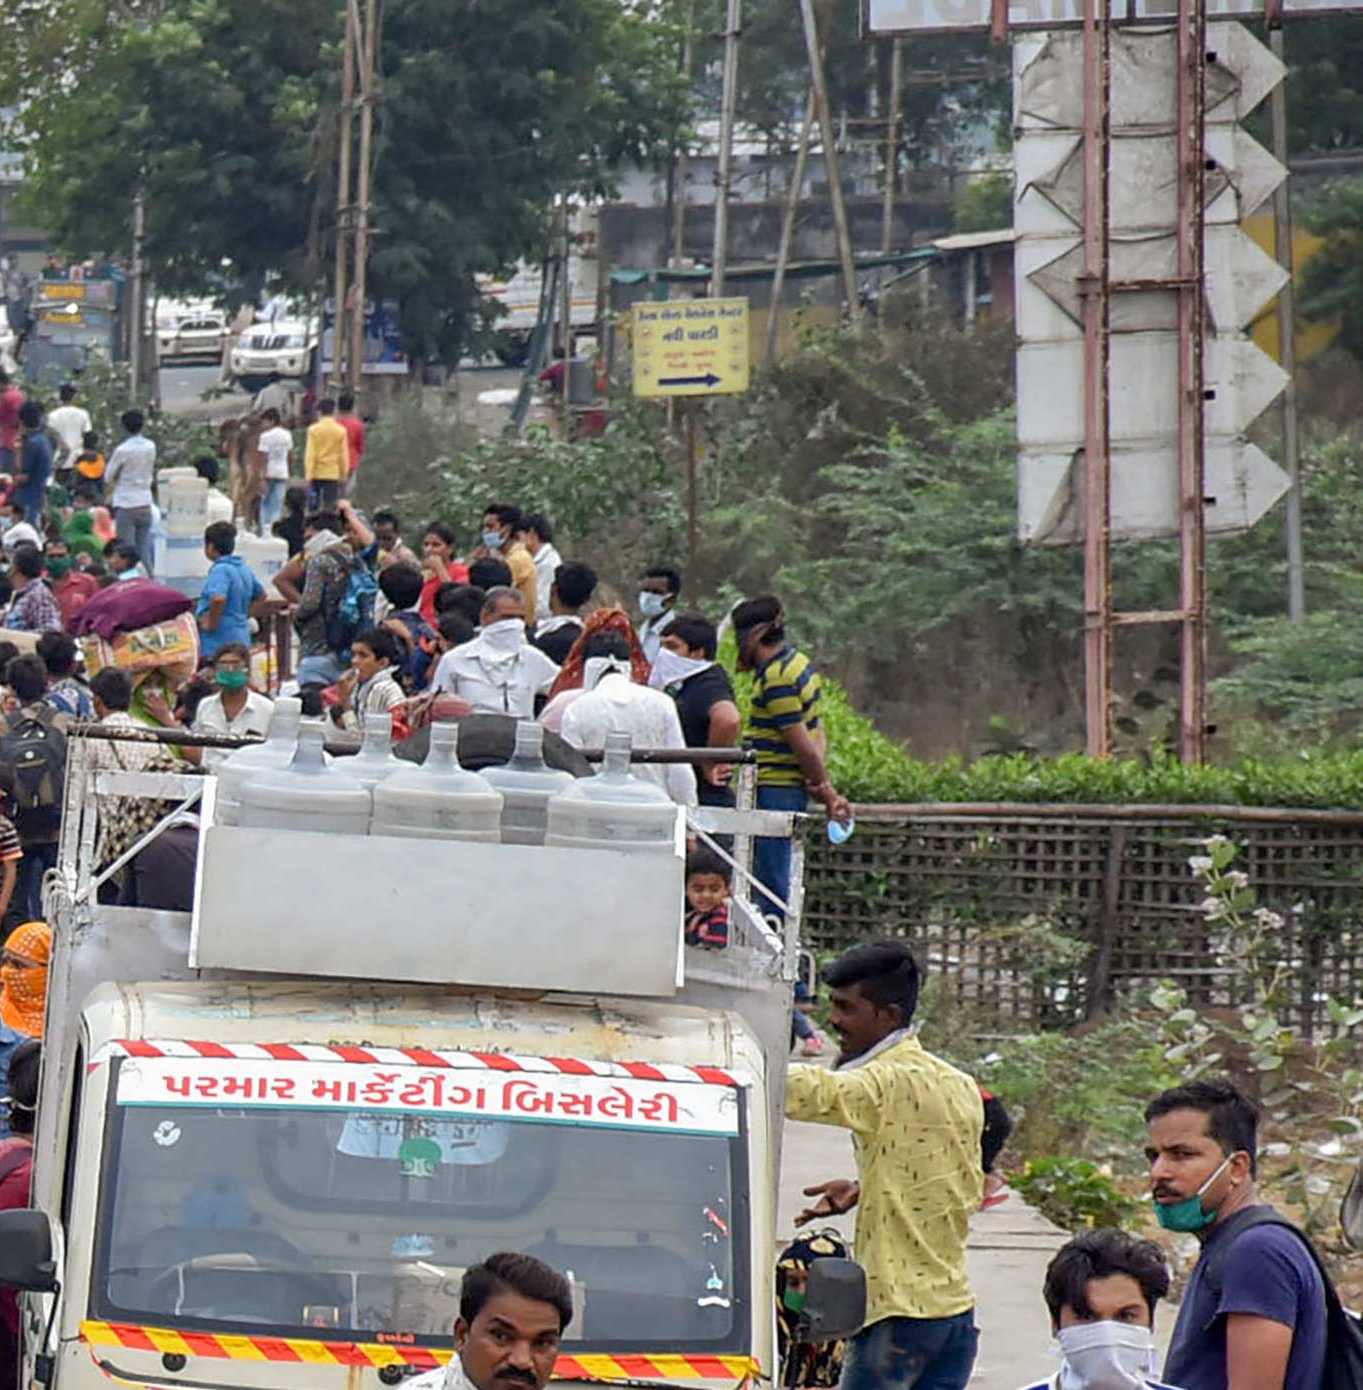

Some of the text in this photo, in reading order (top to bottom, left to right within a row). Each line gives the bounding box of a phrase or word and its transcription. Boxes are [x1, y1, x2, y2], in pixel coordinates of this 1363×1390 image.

[162, 1071, 678, 1123] પરમાર માર્કેટીંગ બિસલેરી
